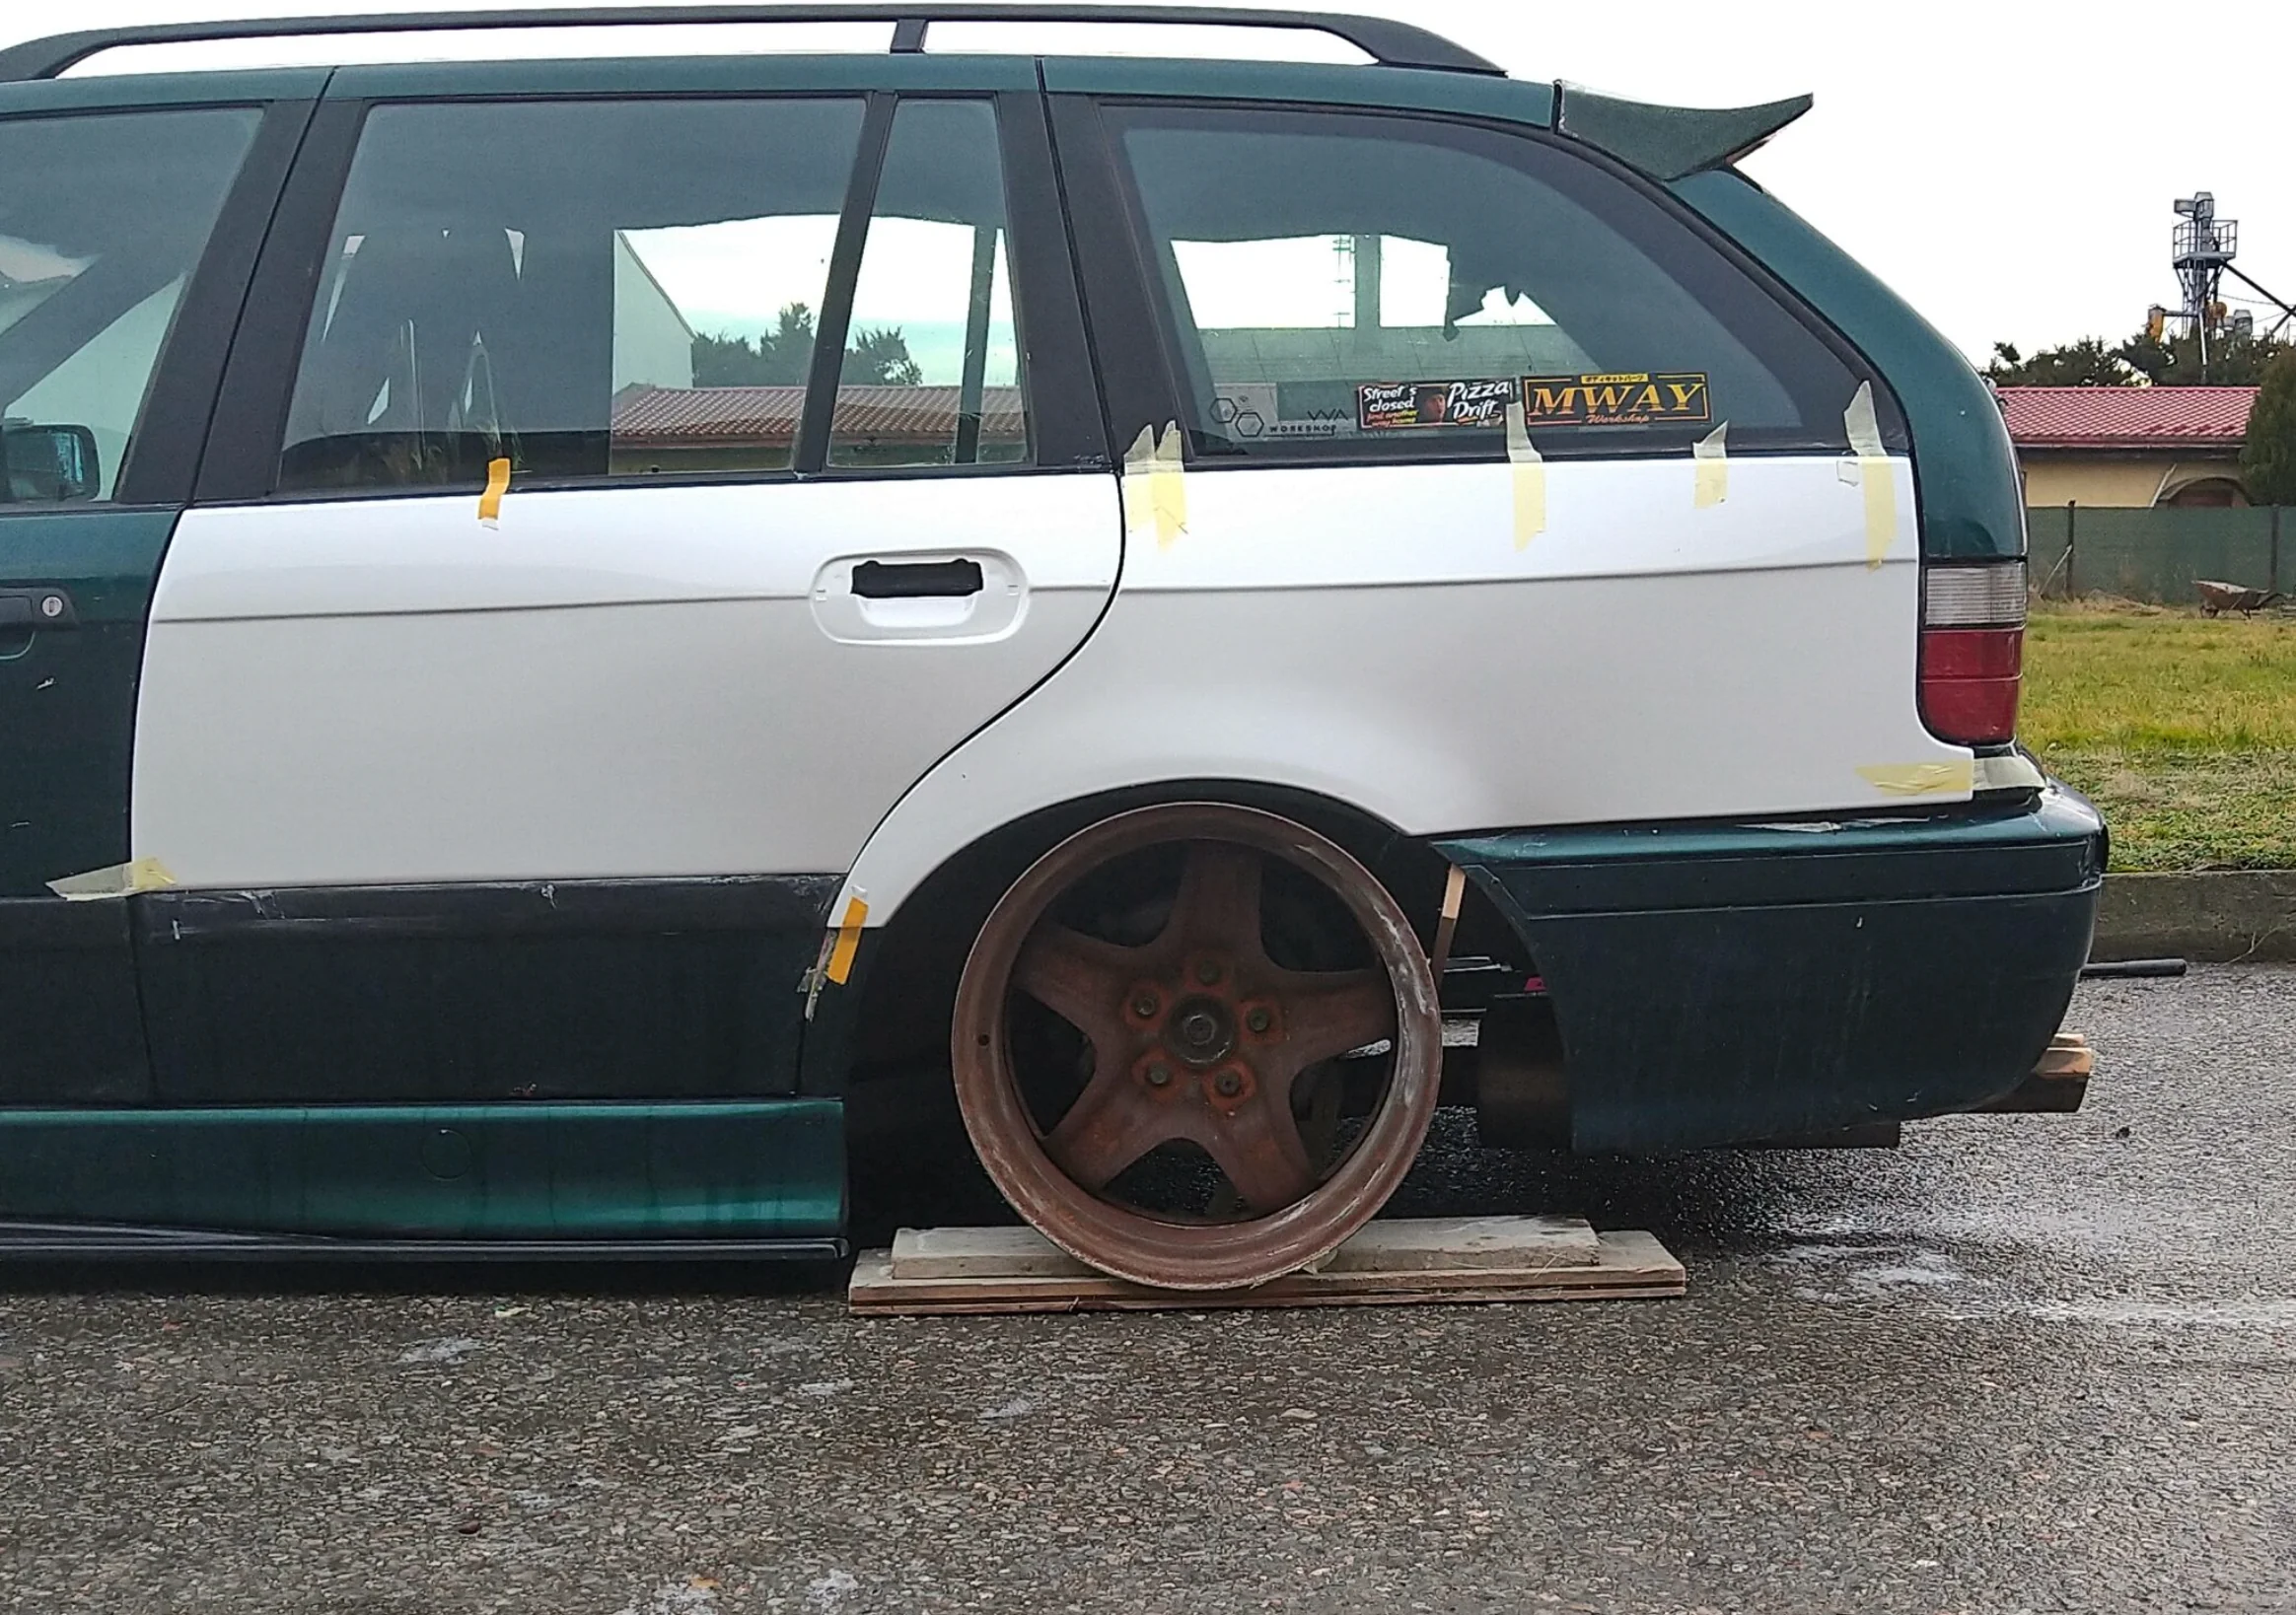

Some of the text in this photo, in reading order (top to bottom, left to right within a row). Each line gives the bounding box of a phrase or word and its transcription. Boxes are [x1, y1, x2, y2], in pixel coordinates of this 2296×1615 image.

[1369, 395, 1415, 412] closed
[1447, 381, 1510, 408] Pizza
[1528, 384, 1705, 416] MWAY
[1453, 398, 1499, 420] Drift
